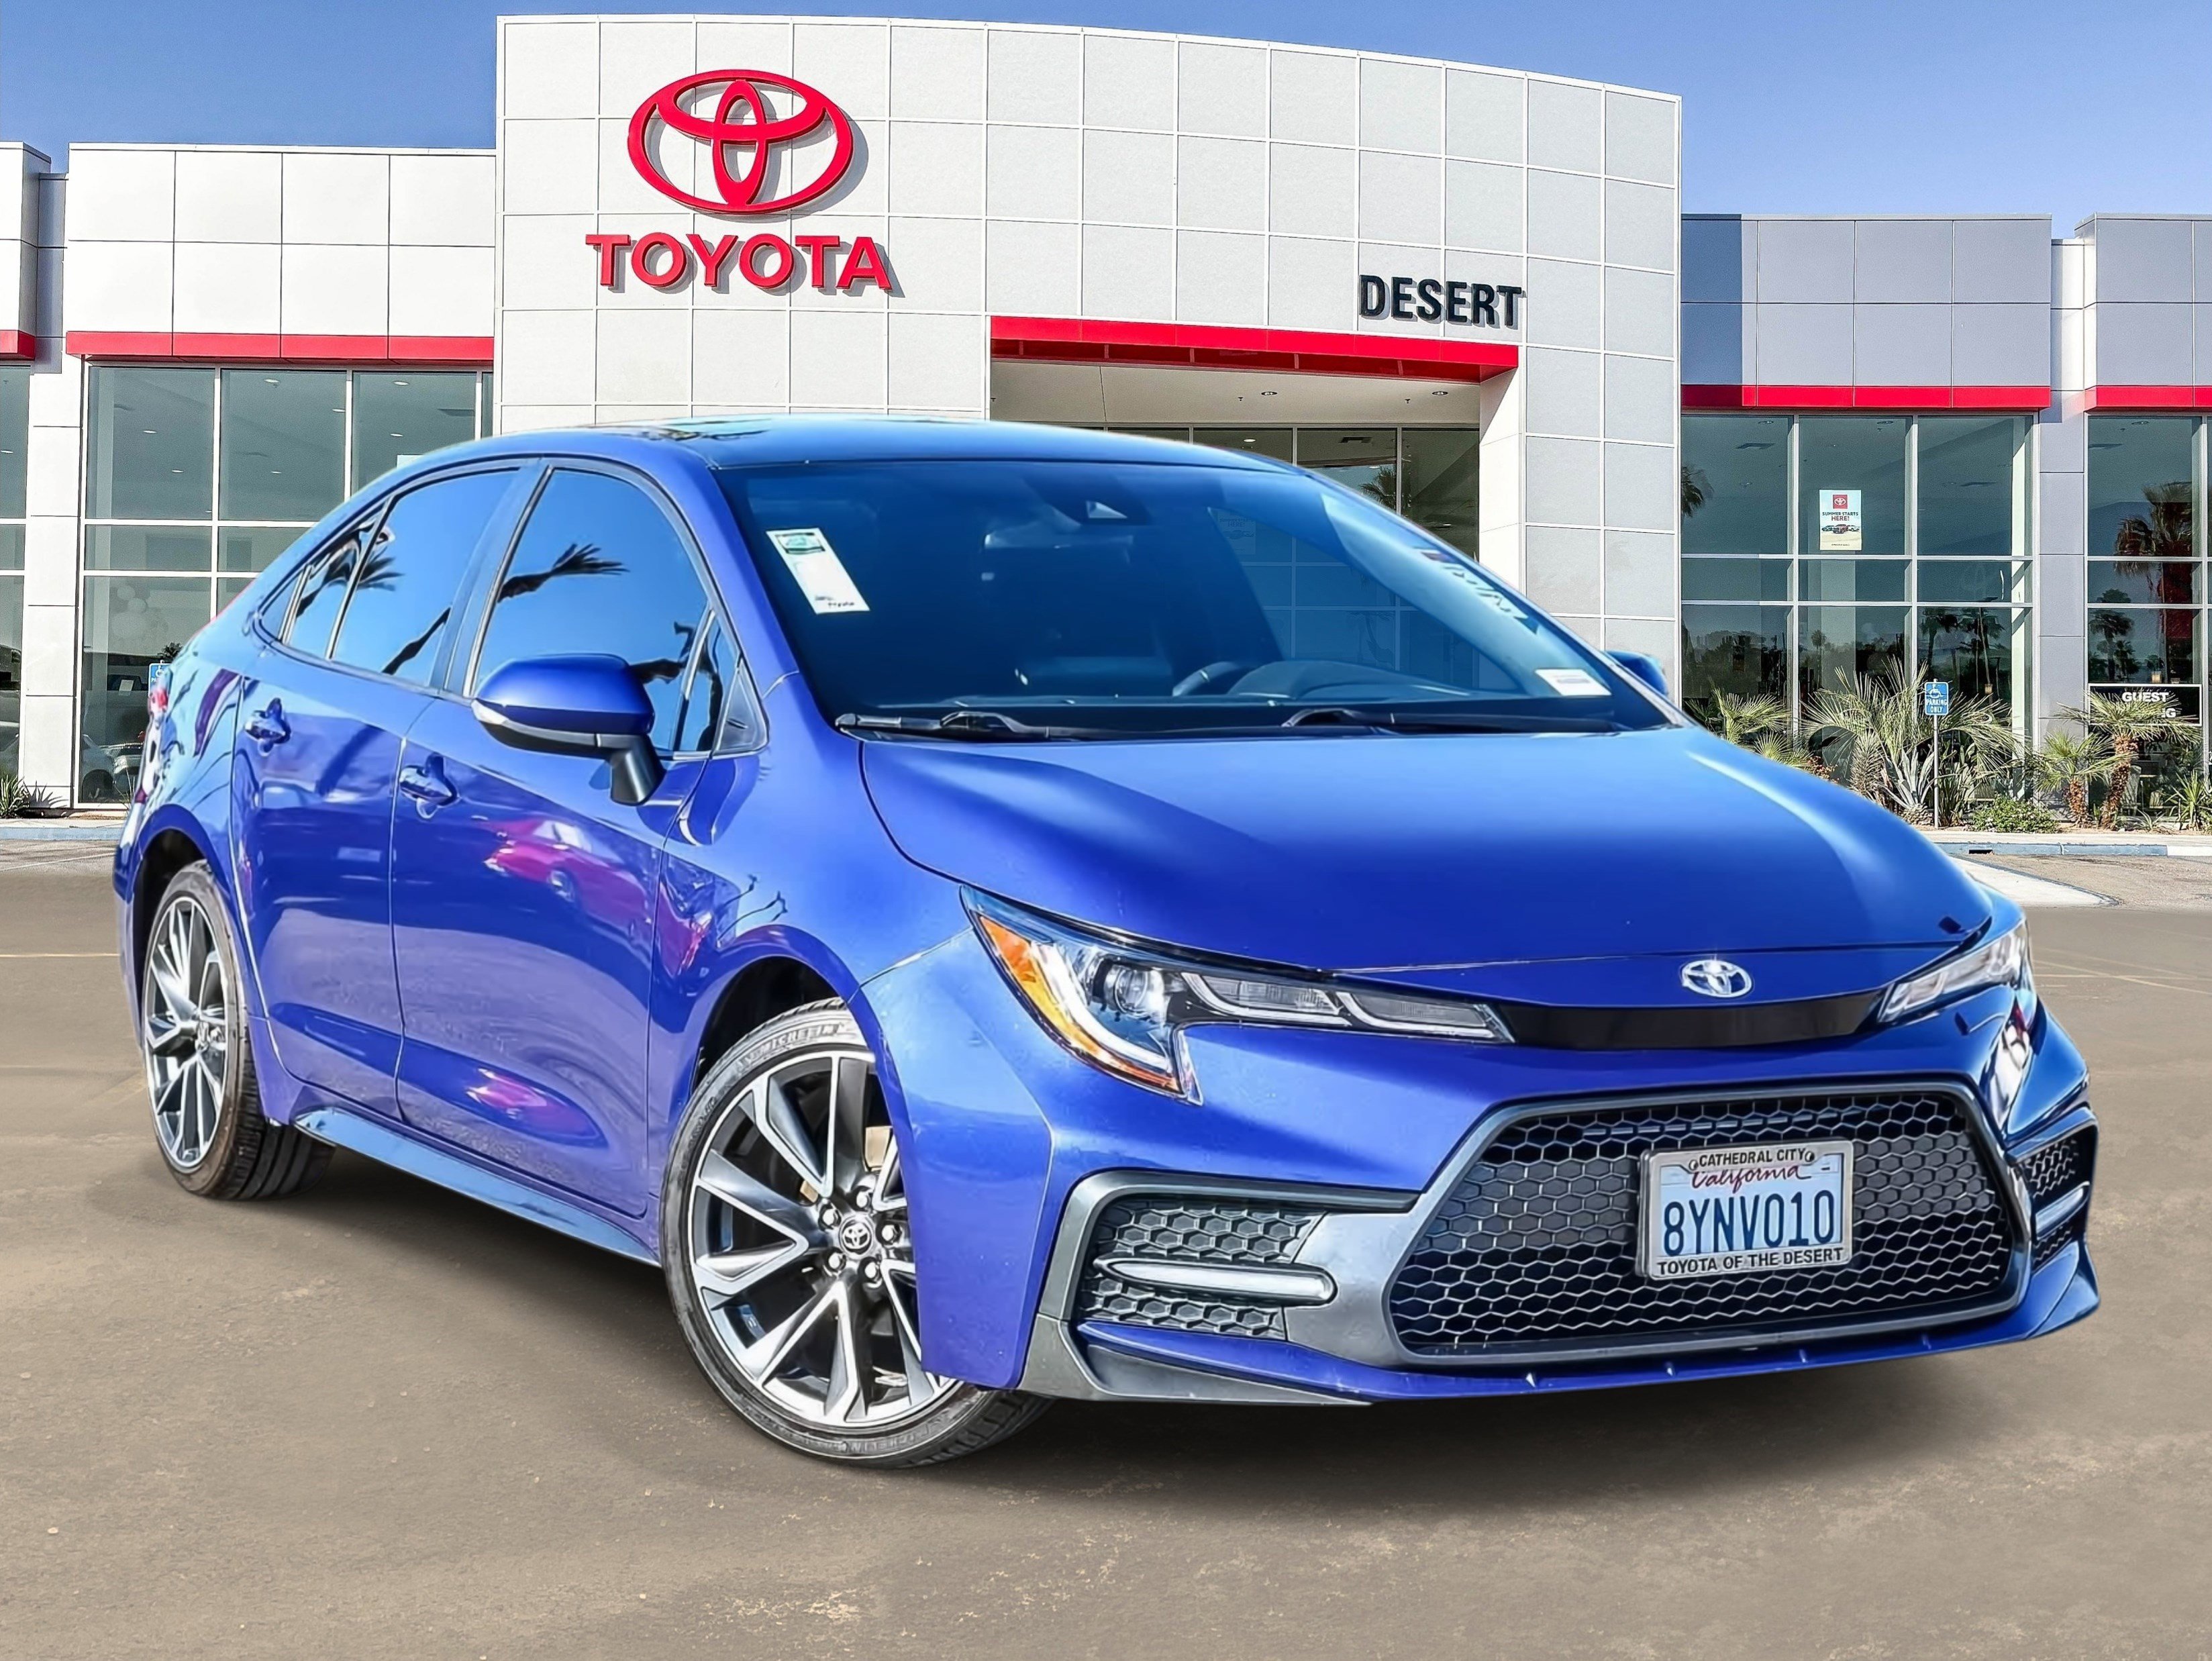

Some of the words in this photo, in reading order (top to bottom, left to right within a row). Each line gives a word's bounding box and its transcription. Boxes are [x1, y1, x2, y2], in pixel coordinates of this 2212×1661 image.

[585, 232, 893, 290] TOYOTA
[1359, 274, 1522, 327] DESERT
[2121, 691, 2169, 703] GUEST
[1699, 1150, 1773, 1166] CATHEDRAL
[1776, 1148, 1806, 1161] CITY
[1691, 1164, 1811, 1194] California
[1663, 1190, 1835, 1256] 8YNV010
[1657, 1258, 1717, 1276] TOYOTA
[1722, 1256, 1744, 1269] OF
[1750, 1252, 1779, 1266] THE
[1783, 1248, 1844, 1264] DESERT
